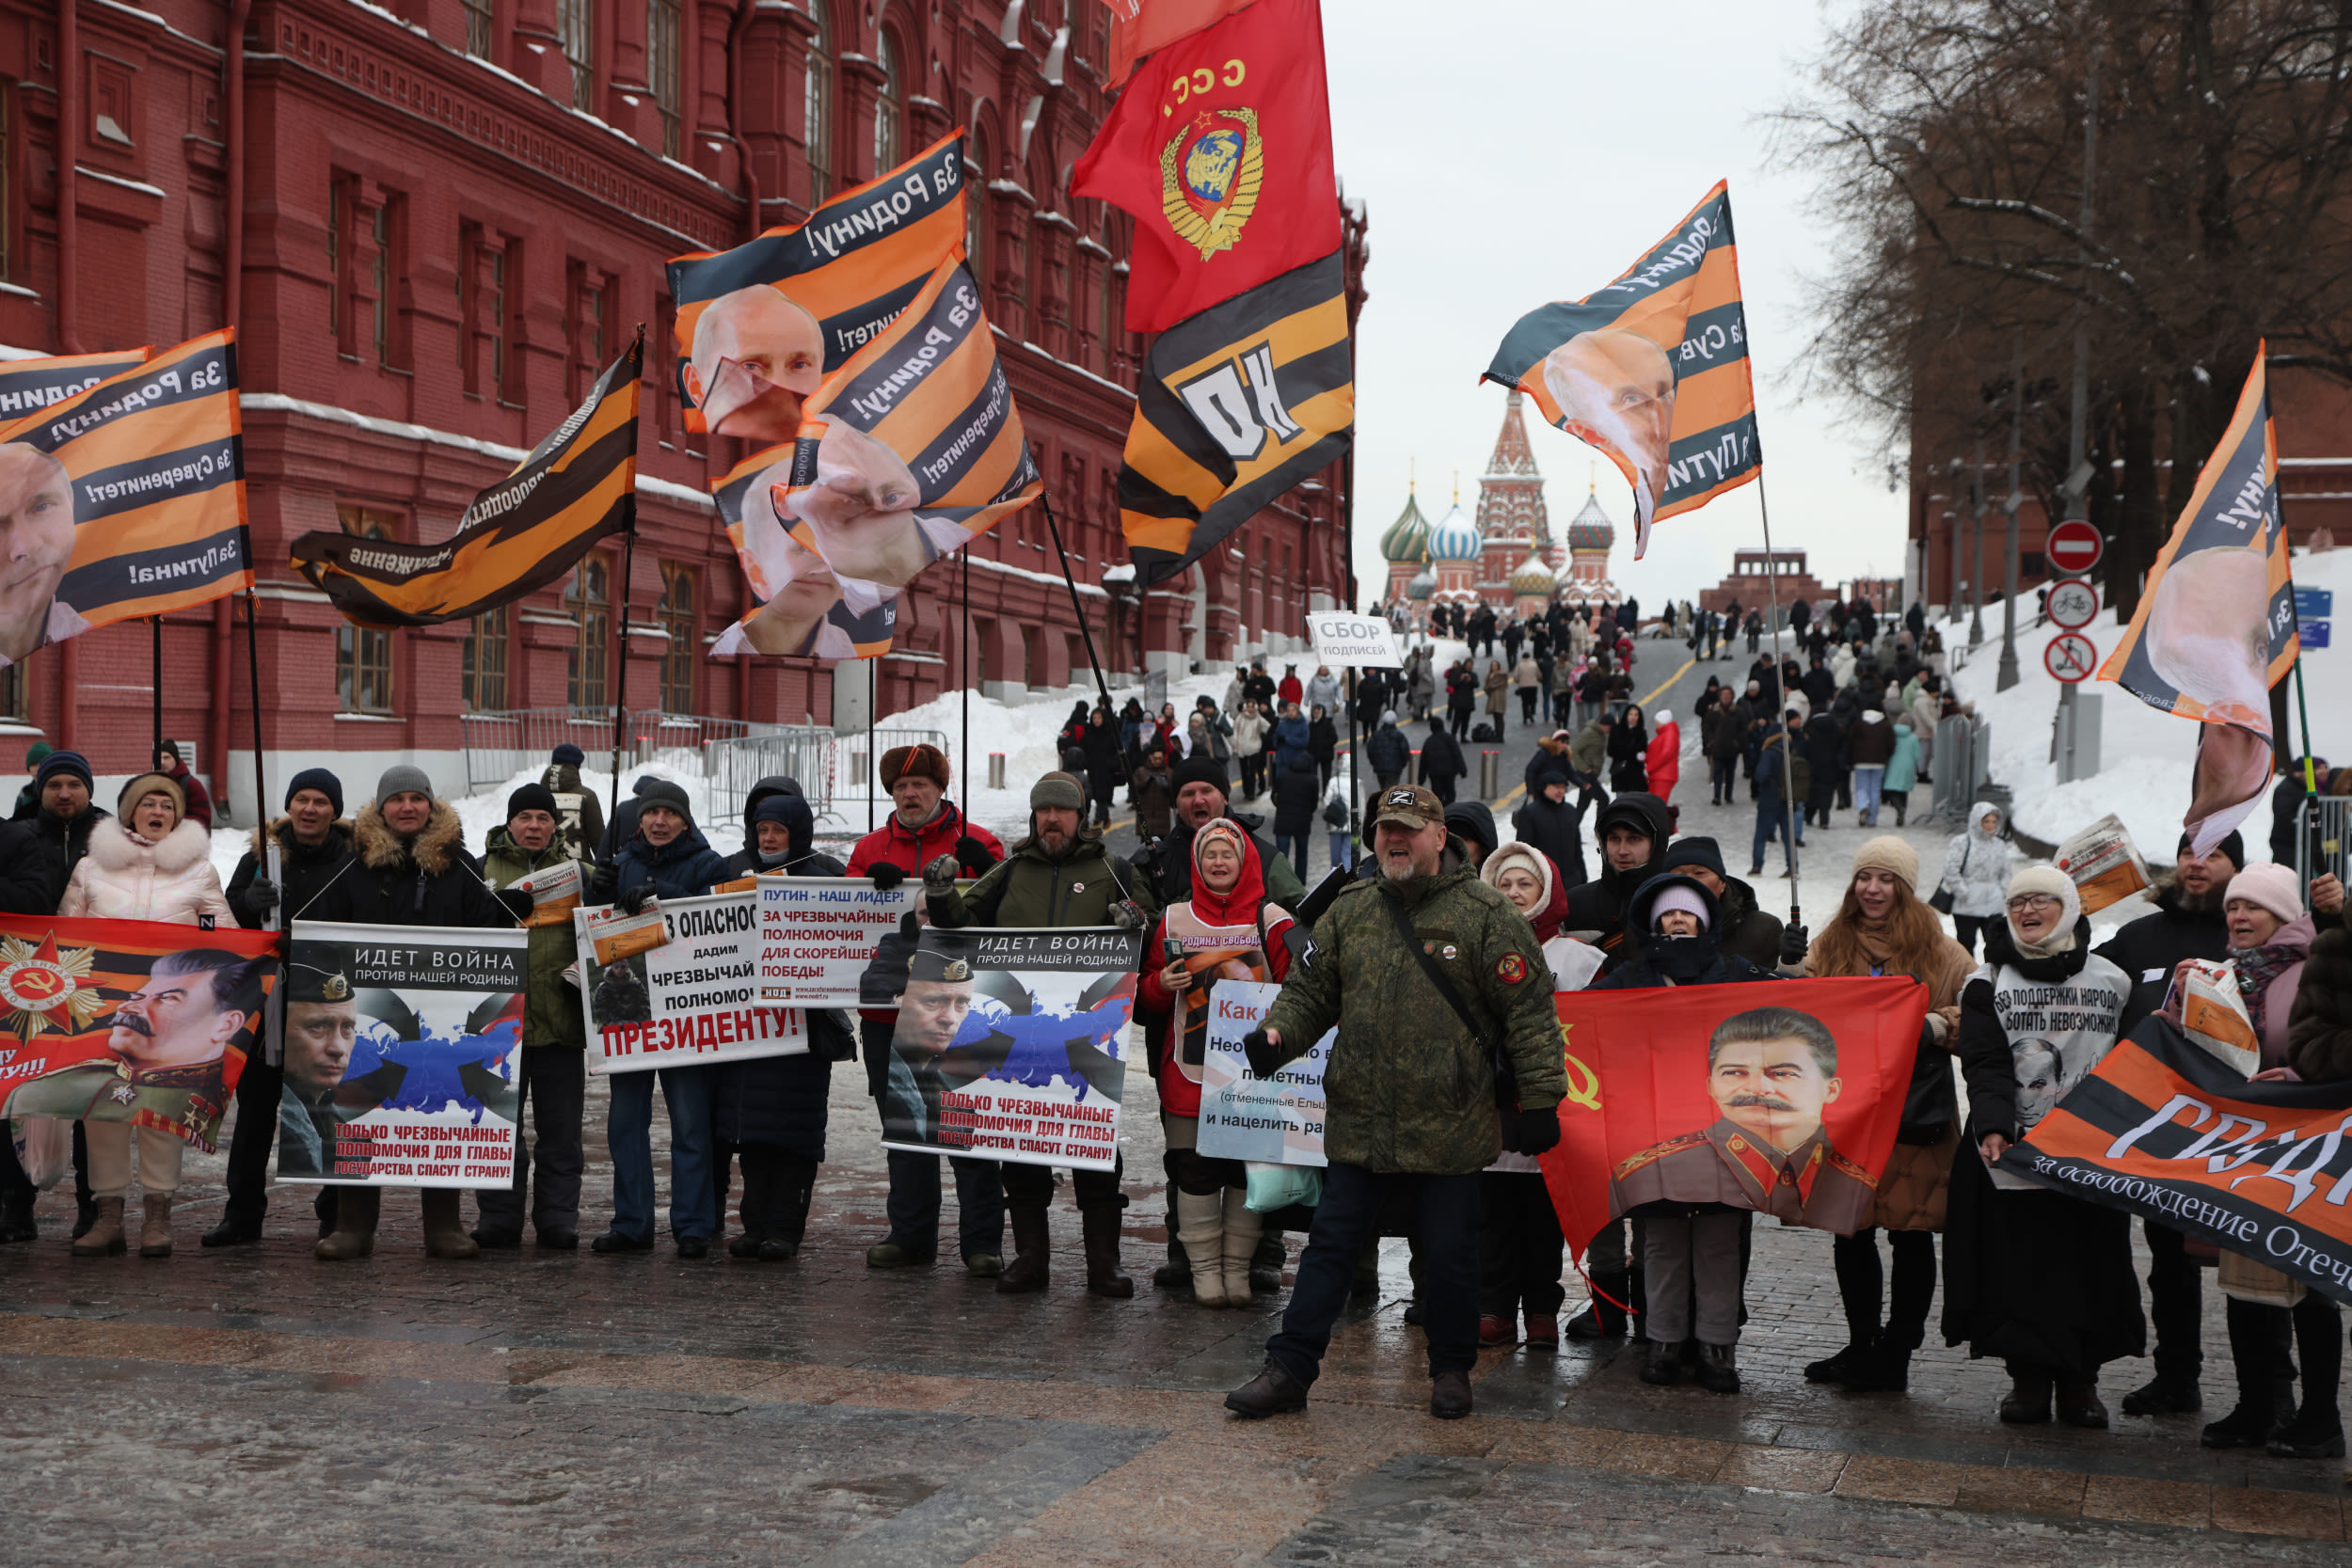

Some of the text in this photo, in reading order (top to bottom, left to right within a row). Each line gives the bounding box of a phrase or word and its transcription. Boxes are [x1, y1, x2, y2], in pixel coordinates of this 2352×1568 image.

[1320, 622, 1380, 640] СБОР
[1325, 644, 1387, 657] ПОДПИСЕЙ
[1391, 791, 1412, 805] Z
[534, 870, 576, 890] СУВЕРЕНИТЕТ
[764, 889, 808, 901] ПУТИН
[818, 890, 851, 902] НАШ
[854, 892, 904, 905] ЛИДЕР!
[763, 909, 897, 924] ЗА ЧРЕЗВЫЧАЙНЫЕ
[763, 928, 864, 942] ПОЛНОМОЧИЯ
[978, 934, 1129, 952] ИДЕТ ВОЙНА
[1182, 935, 1221, 947] РОДИНА!
[355, 948, 515, 970] ИДЕТ ВОЙНА
[693, 945, 738, 959] ДАДИМ
[761, 945, 879, 961] ДЛЯ СКОРЕЙШЕЙ
[977, 953, 1132, 966] ПРОТИВ НАШЕЙ РОДИНЫ!
[355, 970, 518, 986] ПРОТИВ НАШЕЙ РОДИНЫ!
[761, 965, 824, 979] ПОБЕДЫ!
[765, 989, 787, 998] НОД
[1994, 990, 2012, 1013] БЕЗ
[2013, 987, 2078, 1009] ПОДДЕРЖКИ
[1218, 1000, 1258, 1021] Как
[602, 1007, 798, 1056] ПРЕЗИДЕНТУ!
[940, 1091, 1114, 1123] ТОЛЬКО ЧРЕЗВЫЧАЙНЫЕ
[1220, 1091, 1295, 1107] (отмененные
[940, 1111, 1115, 1142] ПОЛНОМОЧИЯ ДЛЯ ГЛАВЫ
[1207, 1114, 1216, 1124] и
[1221, 1115, 1298, 1132] нацелить
[334, 1123, 511, 1142] ТОЛЬКО ЧРЕЗВЫЧАЙНЫЕ
[335, 1142, 513, 1161] ПОЛНОМОЧИЯ ДЛЯ ГЛАВЫ
[938, 1131, 1112, 1161] ГОСУДАРСТВА СПАСУТ СТРАНУ!
[334, 1161, 510, 1178] ГОСУДАРСТВА СПАСУТ СТРАНУ!
[2030, 1156, 2050, 1175] за
[2058, 1164, 2258, 1243] освобождение
